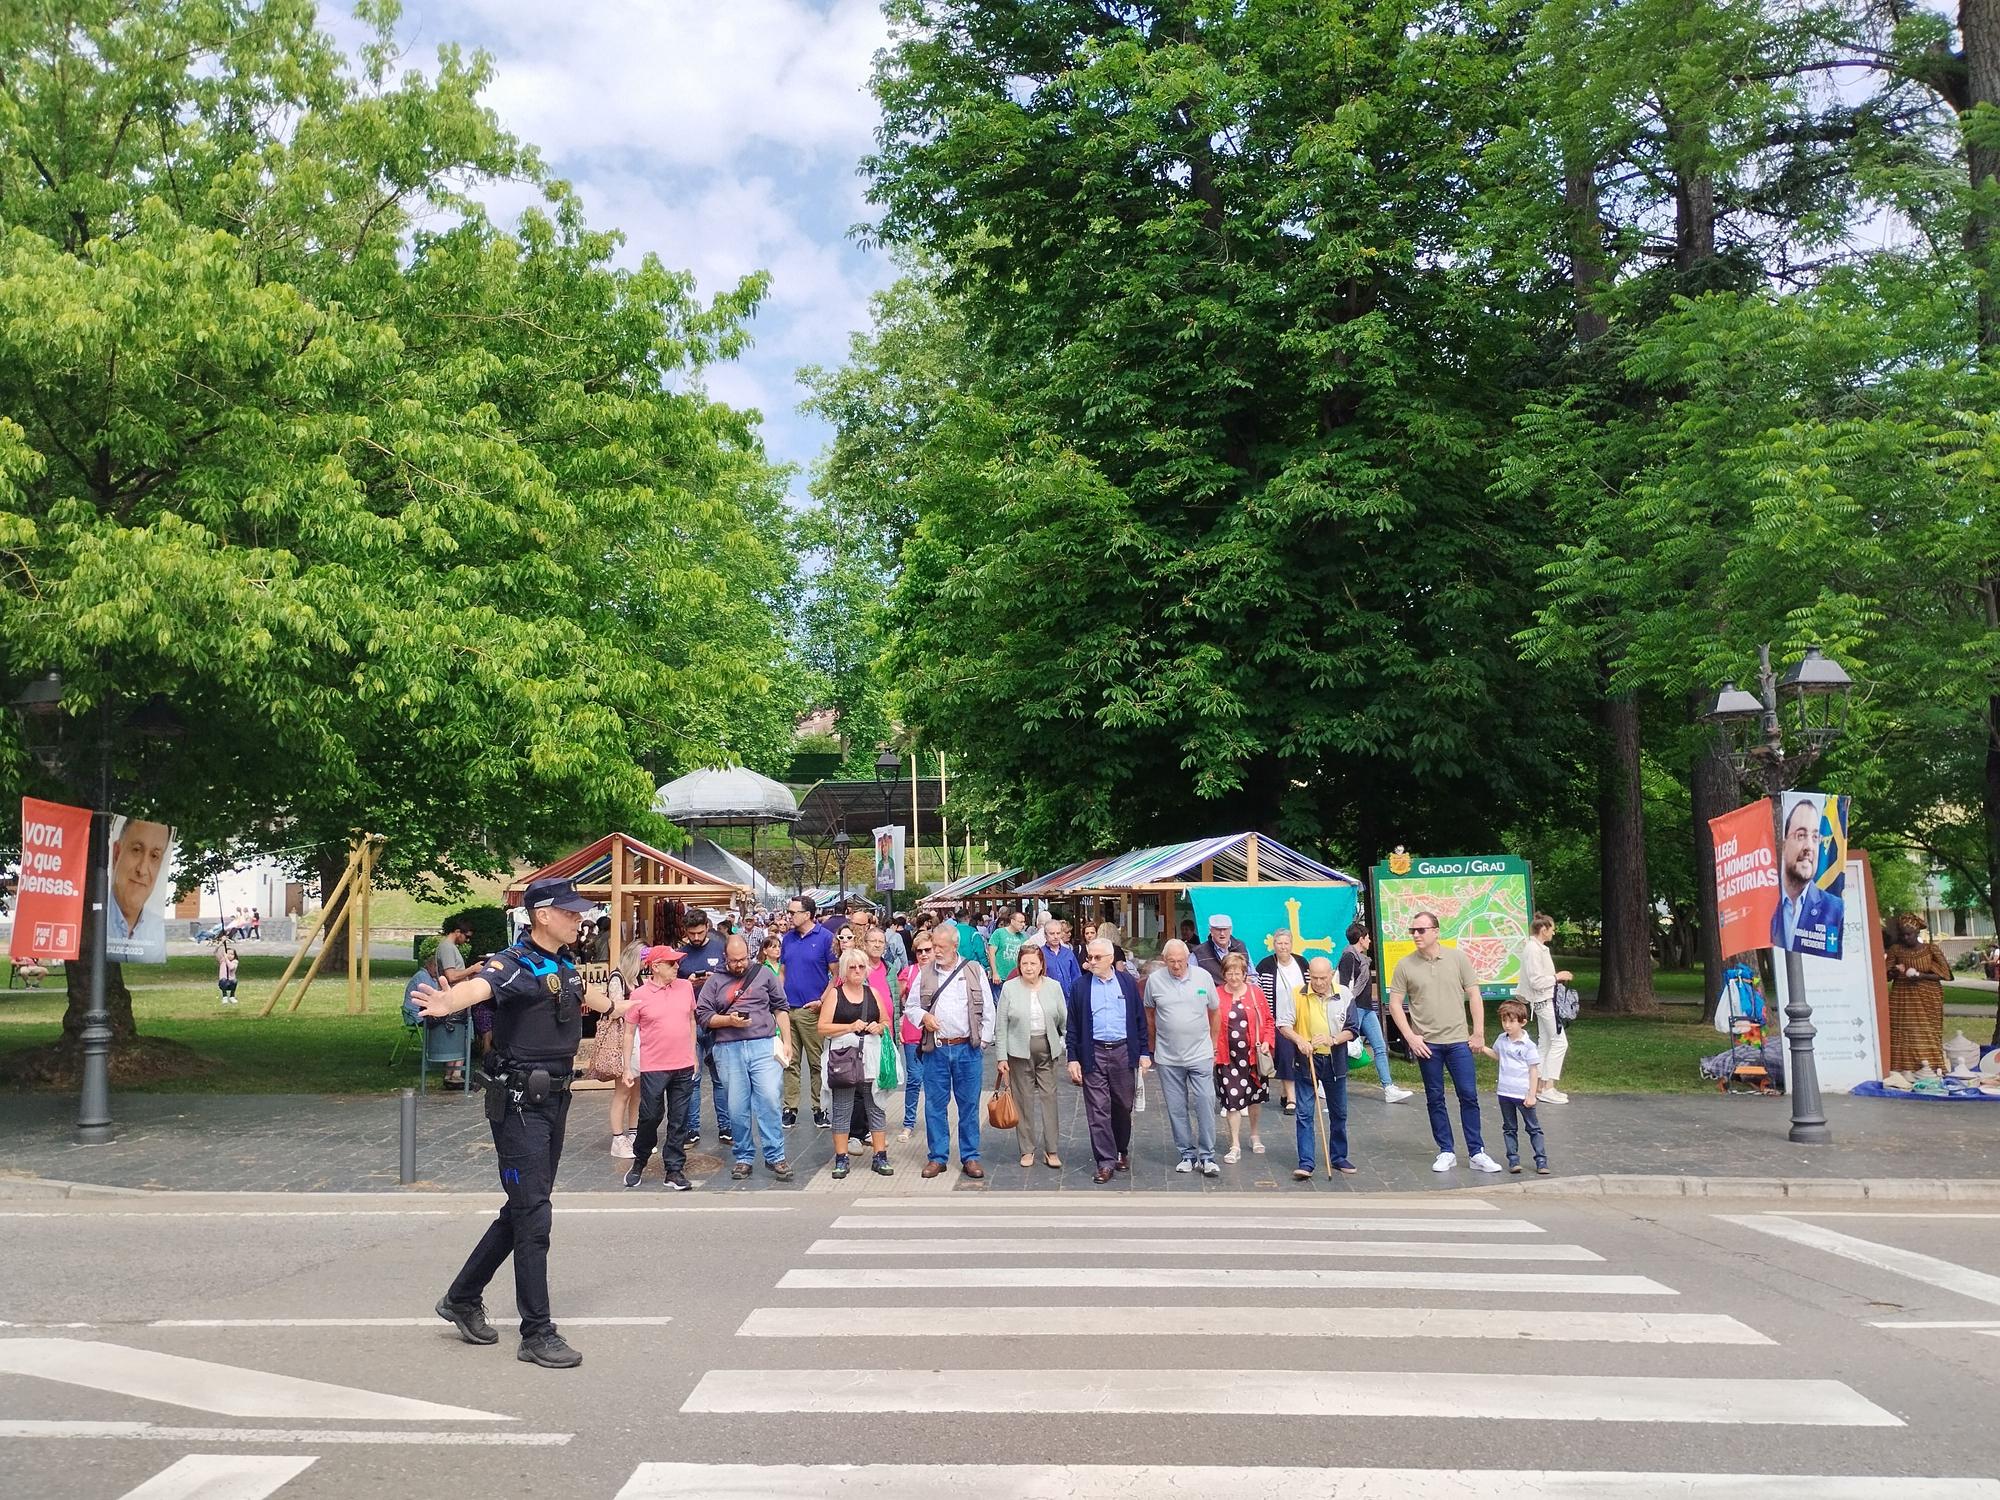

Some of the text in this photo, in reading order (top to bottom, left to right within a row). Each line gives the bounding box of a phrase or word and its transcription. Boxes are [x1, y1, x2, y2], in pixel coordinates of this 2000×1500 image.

[25, 821, 63, 849] VOTA
[33, 852, 62, 874] que
[1418, 861, 1462, 875] GRADO
[1724, 847, 1772, 879] MOMENTO
[20, 869, 79, 897] piensas.
[1726, 868, 1779, 899] ASTURIAS
